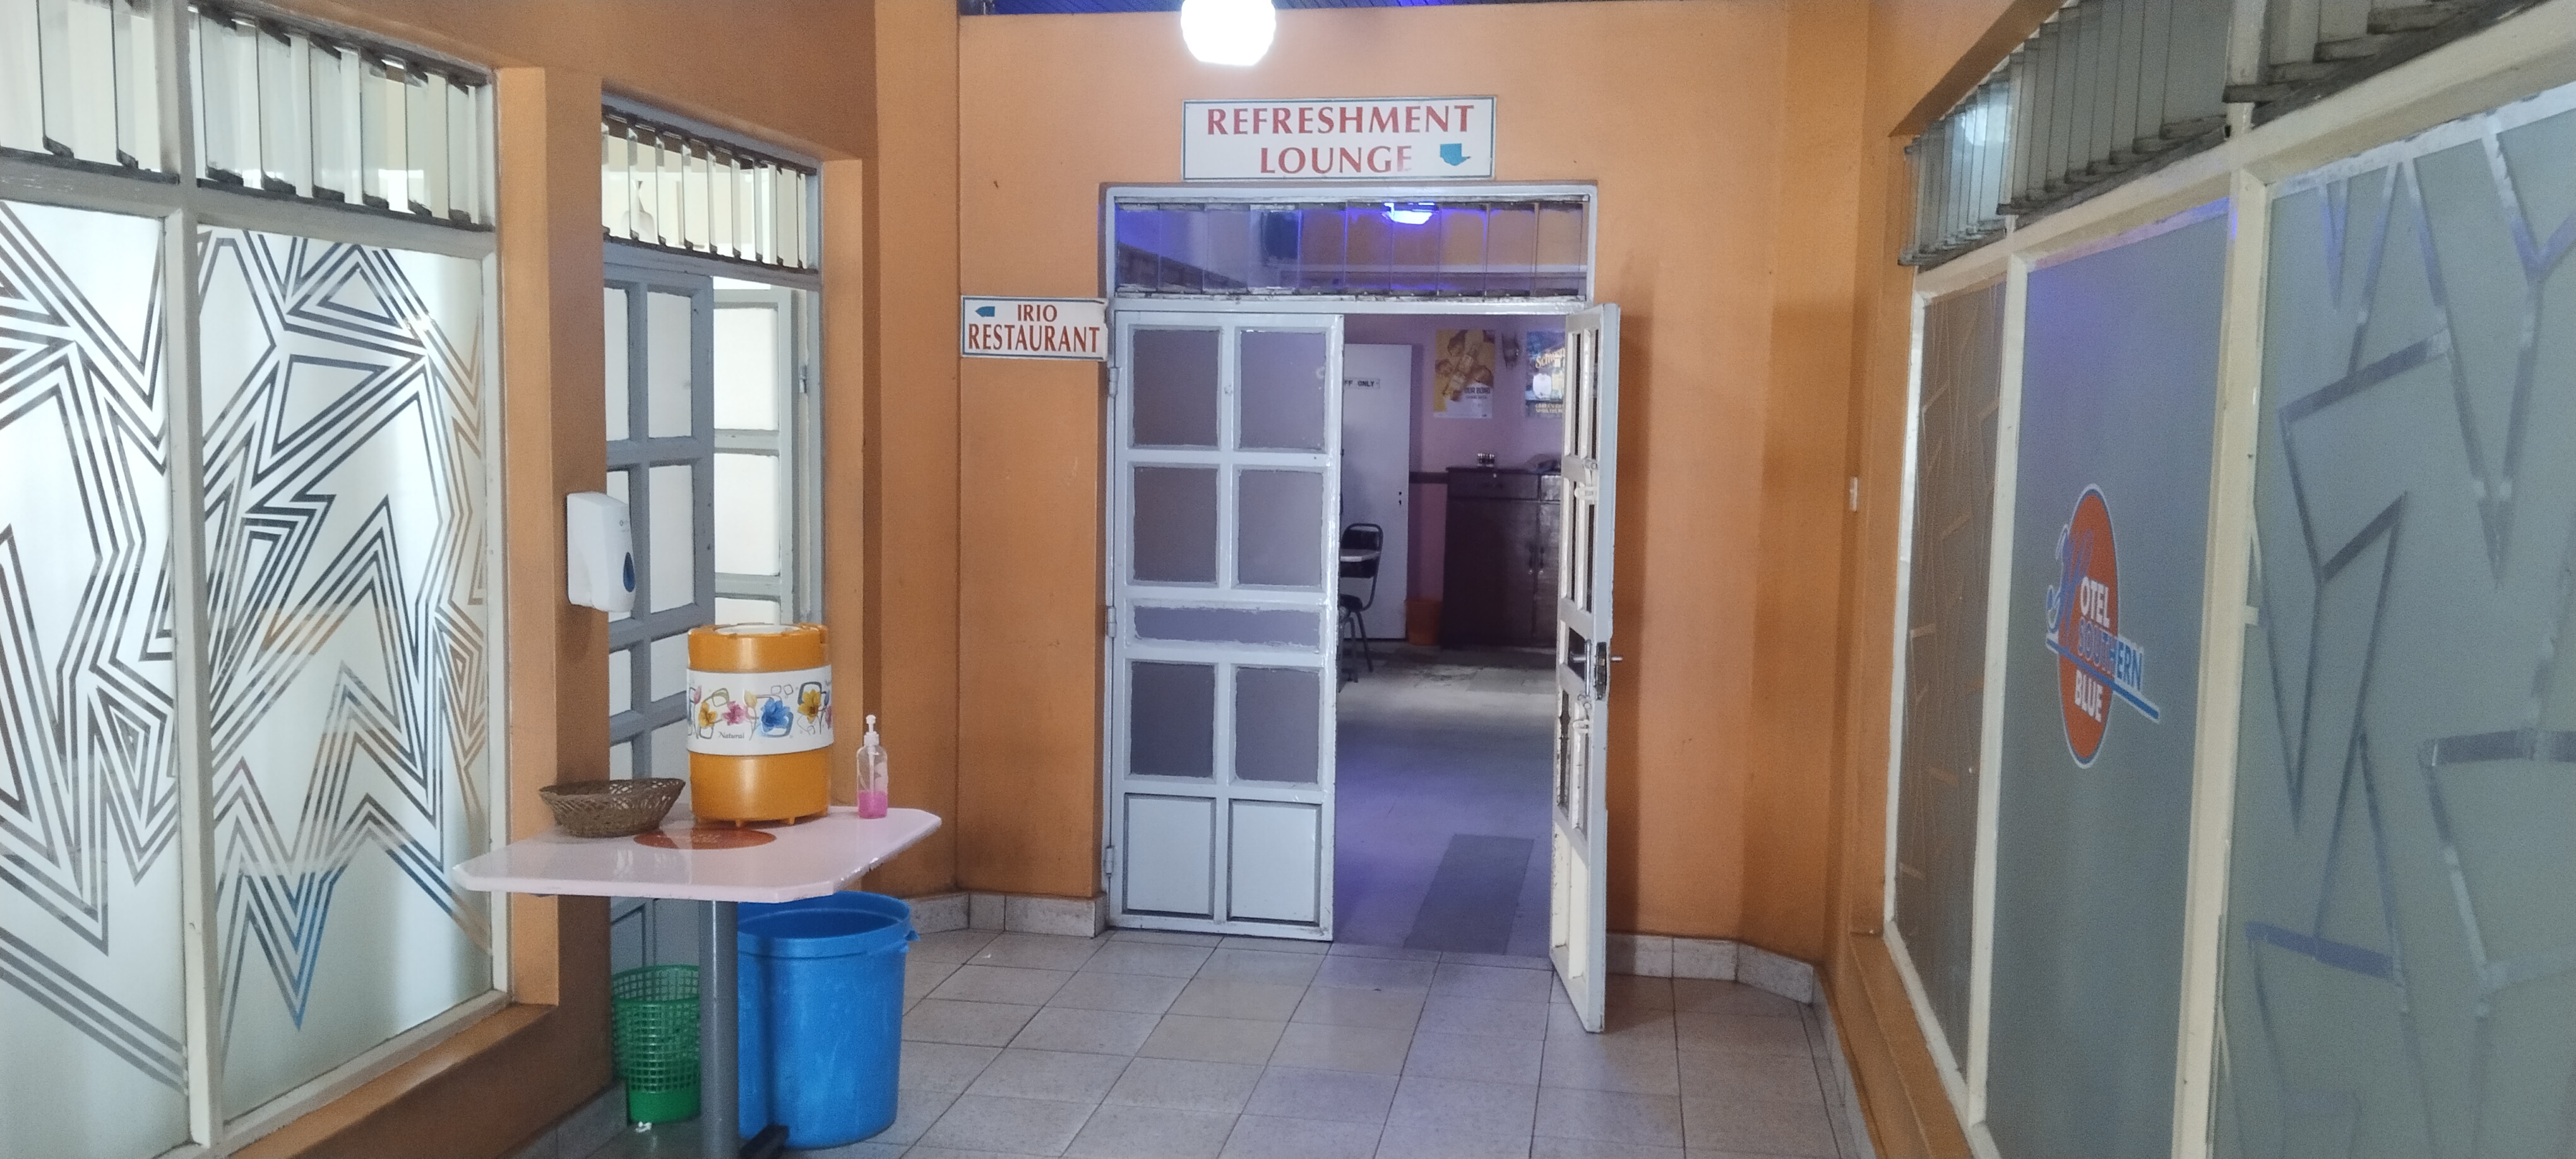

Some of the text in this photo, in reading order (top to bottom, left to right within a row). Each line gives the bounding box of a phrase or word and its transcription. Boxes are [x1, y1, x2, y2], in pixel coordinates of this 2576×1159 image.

[1207, 105, 1475, 135] REFRESHMENT
[1260, 145, 1412, 174] LOUNGE
[1017, 304, 1058, 322] IRIO
[969, 323, 1100, 352] RESTAURANT
[2077, 616, 2145, 691] SOUTHERN
[2075, 669, 2104, 723] BLUE
